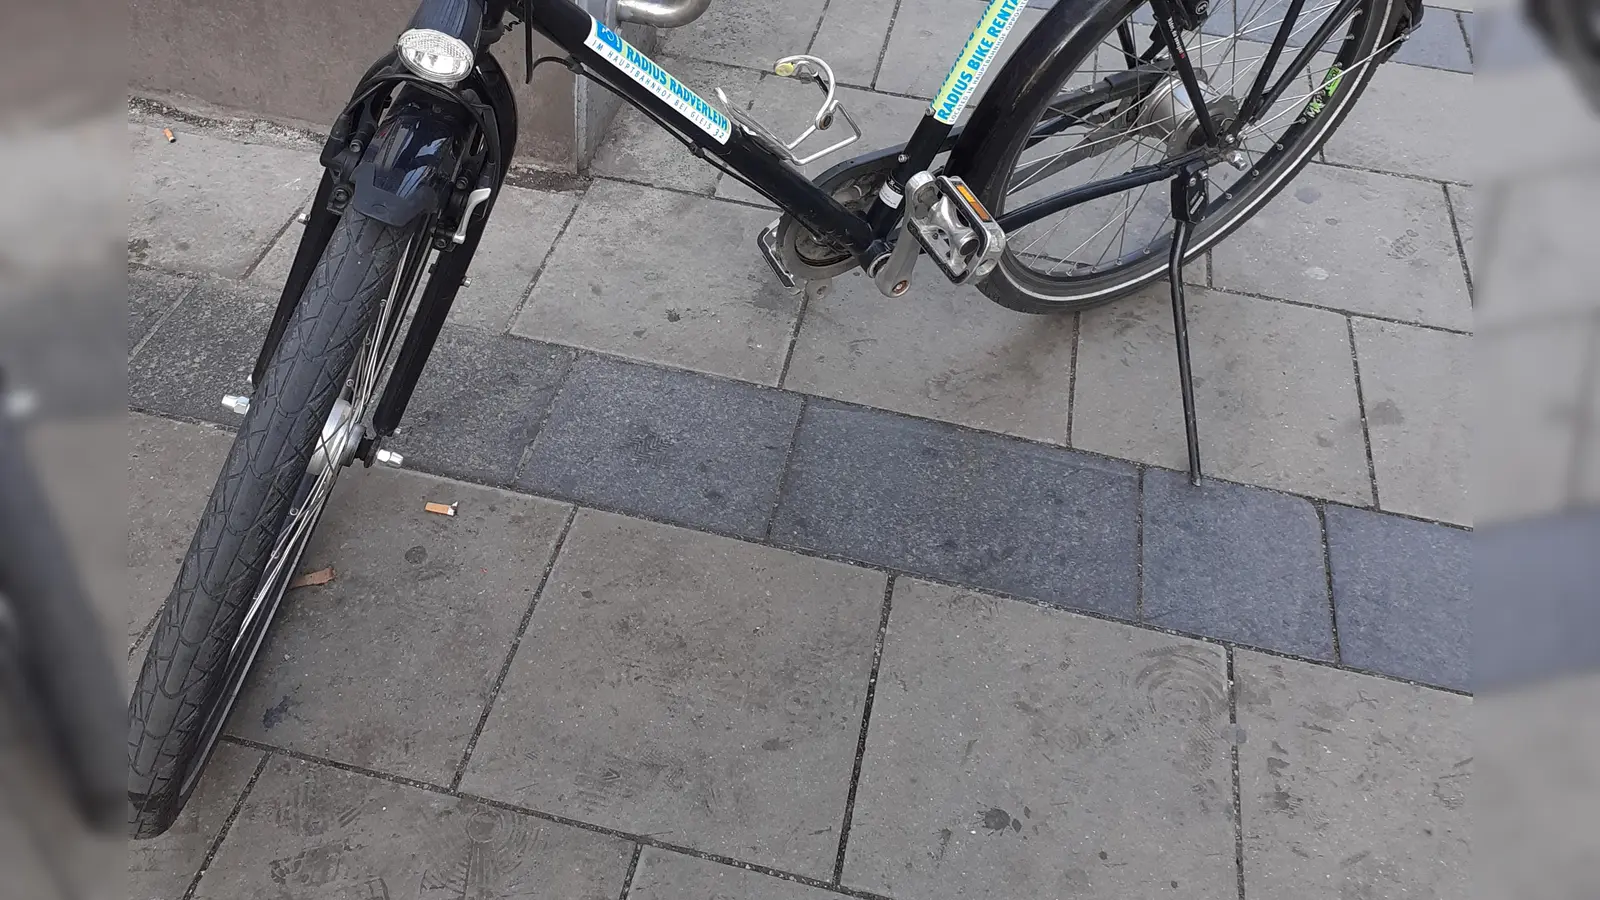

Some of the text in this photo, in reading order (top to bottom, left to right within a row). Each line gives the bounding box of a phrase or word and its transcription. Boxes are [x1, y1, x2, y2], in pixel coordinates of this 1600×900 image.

[592, 39, 725, 139] IM HAUPTBAHNHOF BEI GLEIS 32
[626, 45, 728, 131] RADIUS RADVERLEIH
[937, 71, 973, 120] RADIUS
[967, 37, 994, 71] BIKE
[949, 92, 969, 123] LOCATED
[972, 33, 1007, 85] HAUPTBAHNHOF
